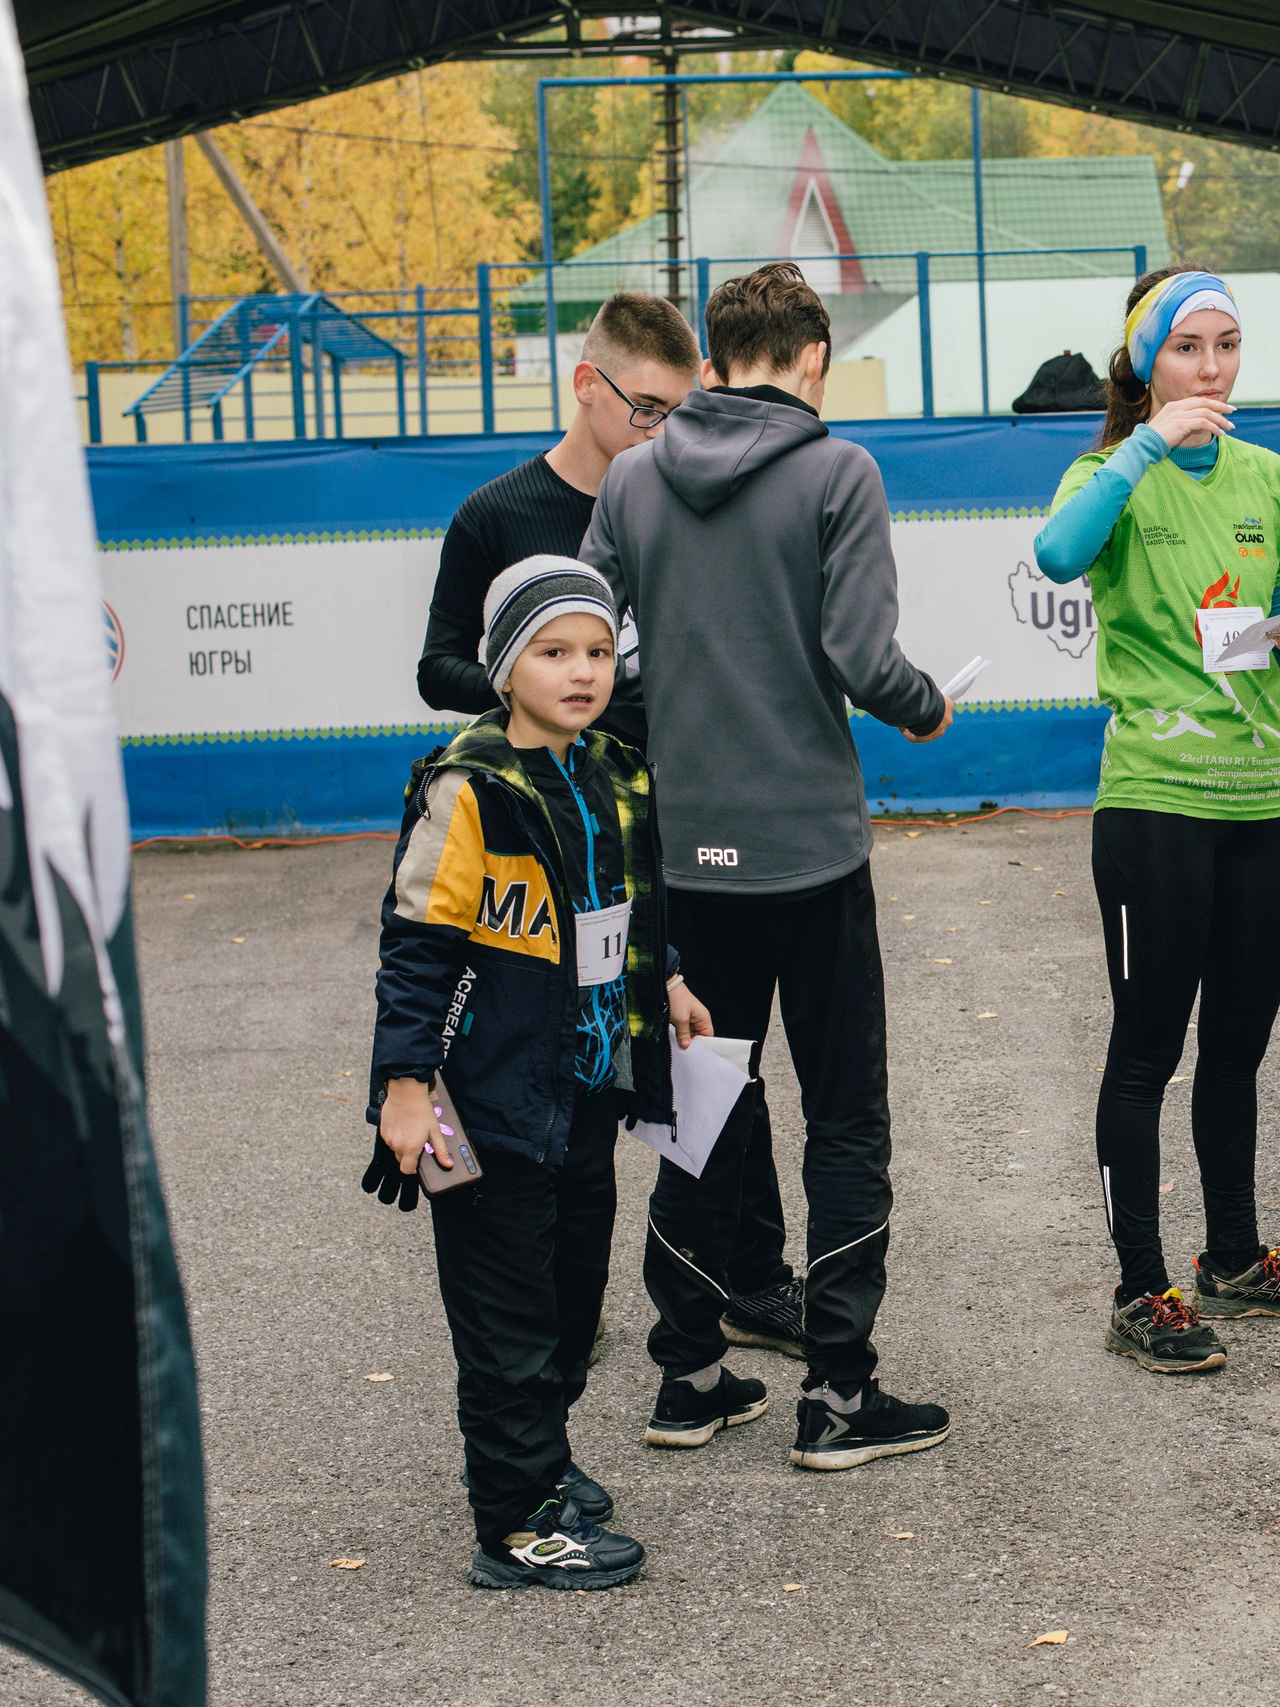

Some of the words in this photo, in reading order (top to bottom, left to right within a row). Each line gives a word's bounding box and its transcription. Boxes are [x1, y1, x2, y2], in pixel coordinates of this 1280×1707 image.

[186, 601, 294, 630] СПАСЕНИЕ
[1030, 591, 1093, 638] Ugr
[189, 648, 252, 676] ЮГРЫ
[1180, 753, 1203, 764] 23rd
[1205, 755, 1233, 766] IARU
[1163, 774, 1185, 784] 18th
[1188, 777, 1216, 788] IARU
[1236, 780, 1272, 790] European
[1207, 767, 1270, 779] Championships
[1203, 790, 1265, 802] Championships
[697, 847, 738, 866] PRO
[601, 931, 622, 960] 11
[441, 965, 477, 1060] ACEREAR
